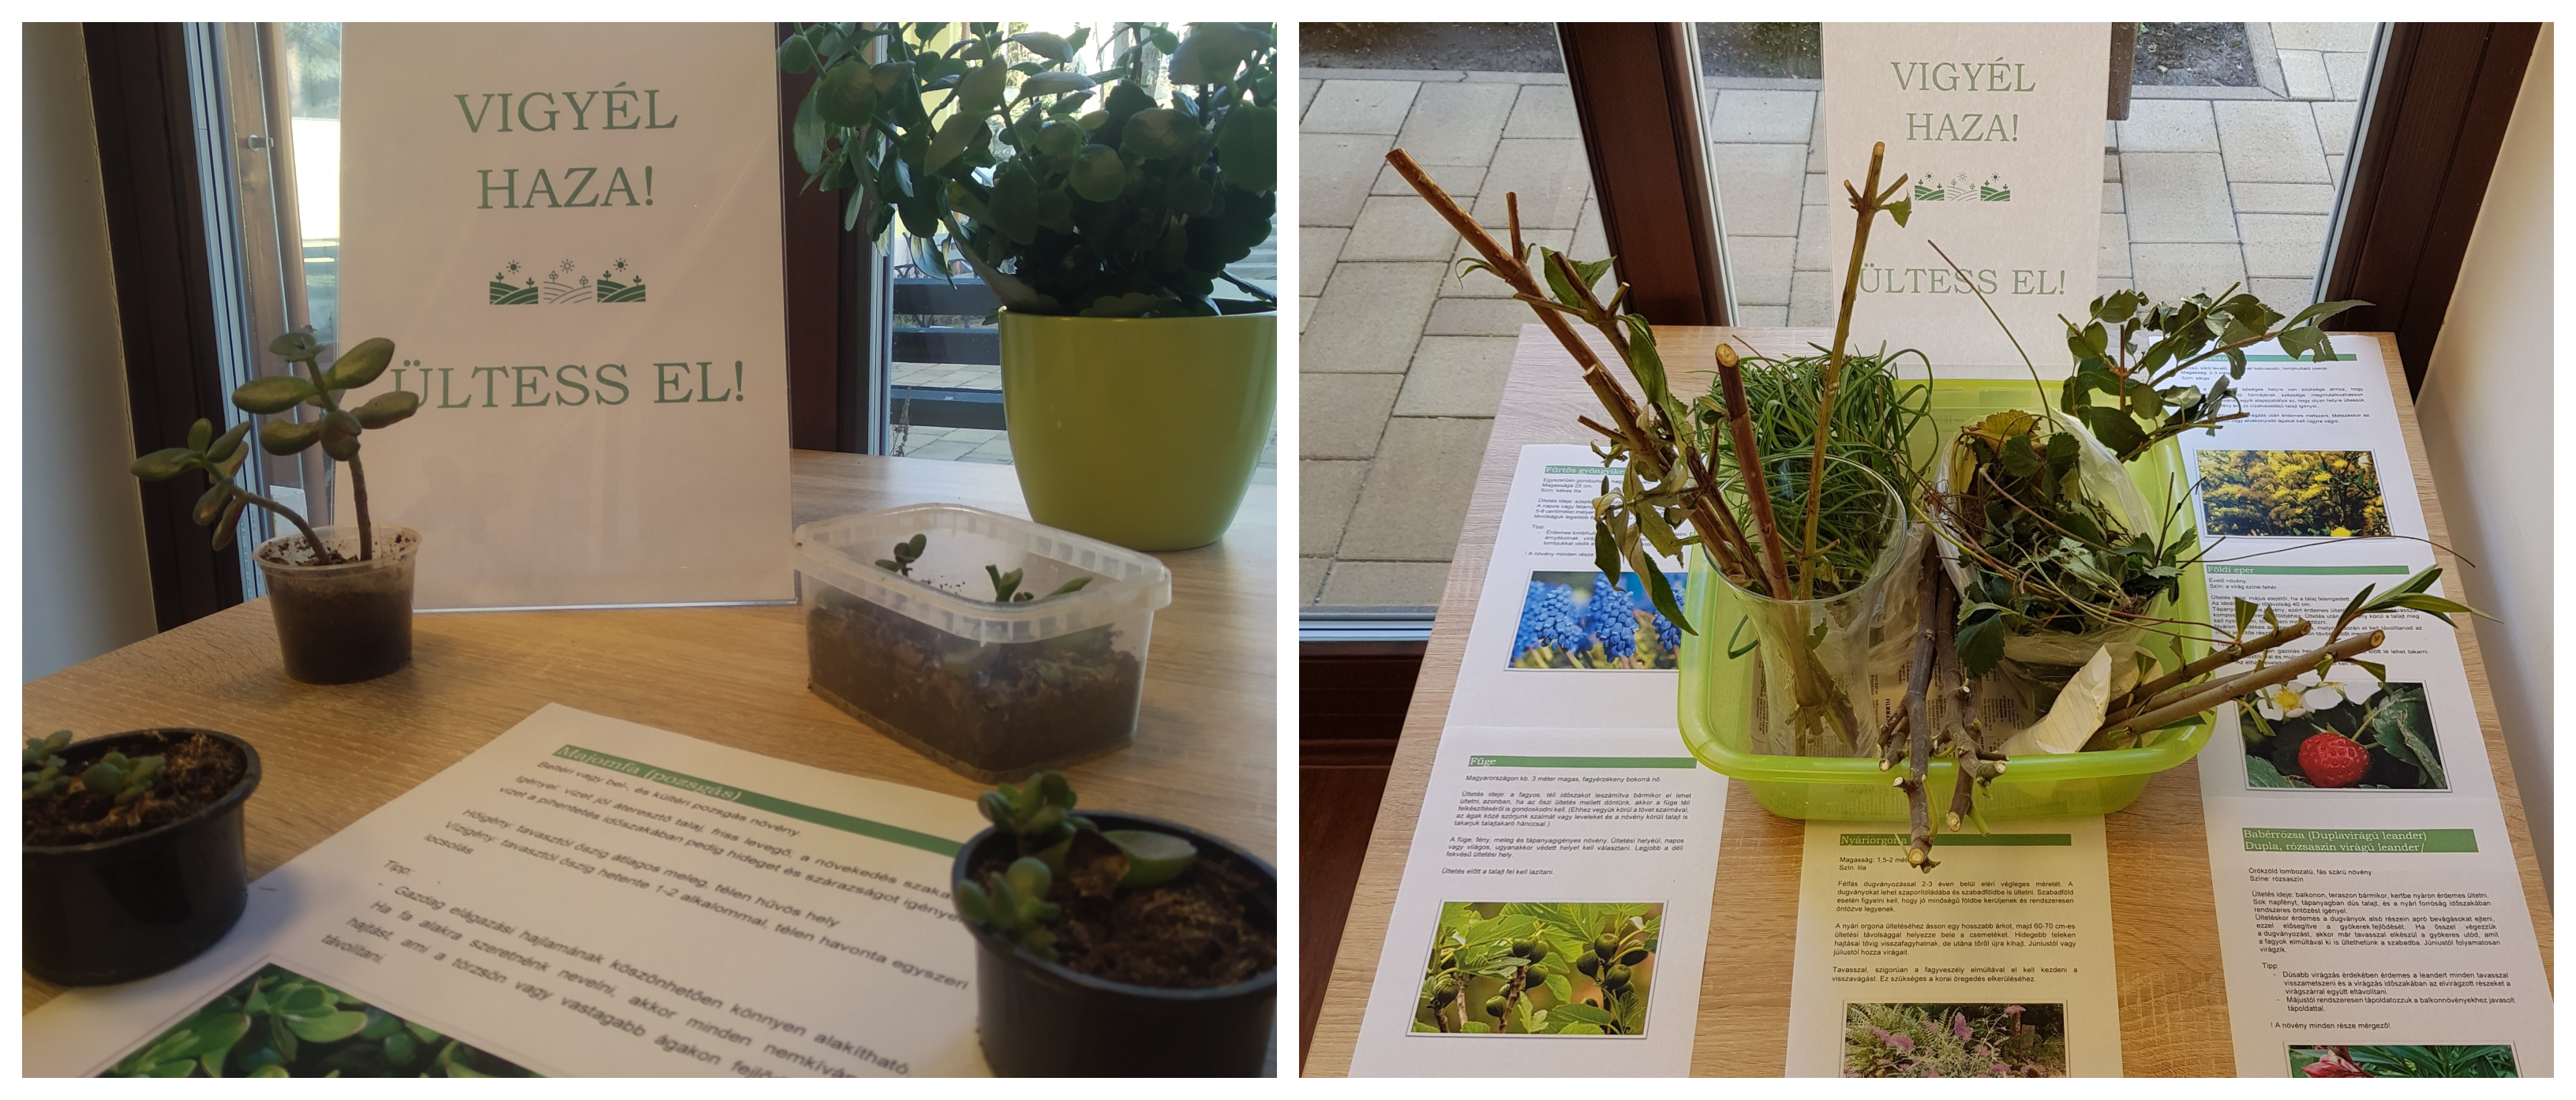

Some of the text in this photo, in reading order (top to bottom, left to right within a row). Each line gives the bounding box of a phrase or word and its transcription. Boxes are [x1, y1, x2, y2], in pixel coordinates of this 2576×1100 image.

[1891, 57, 2036, 92] VIGYÉL
[454, 82, 678, 134] VIGYÉL
[1906, 113, 2019, 142] HAZA!
[477, 166, 655, 210] HAZA!
[1859, 263, 2066, 295] ÜLTESS EL!
[390, 360, 745, 410] ÜLTESS EL!
[556, 746, 743, 803] Majomfa (pozsgás)
[1470, 757, 1496, 766] Füge
[575, 772, 605, 782] vagy
[691, 803, 748, 821] pozsgás
[423, 833, 474, 854] locsolás
[499, 787, 529, 797] vizet
[535, 797, 601, 819] pihentetés
[601, 816, 685, 842] időszakában
[683, 839, 725, 855] pedig
[726, 850, 782, 871] hideget
[783, 867, 803, 877] és
[804, 874, 901, 903] szárazságot
[564, 788, 595, 799] vizet
[612, 803, 673, 821] áteresztő
[710, 828, 740, 840] friss
[814, 859, 898, 883] növekedés
[2243, 829, 2427, 841] Babérrózsa (Duplavirágú leander)
[2245, 842, 2282, 851] Dupla,
[2286, 842, 2336, 851] rózsaszín
[516, 825, 575, 847] tavasztól
[574, 843, 611, 859] őszig
[611, 854, 662, 872] átlagos
[714, 884, 753, 901] télen
[805, 911, 841, 927] hely
[500, 839, 561, 861] tavasztól
[559, 858, 597, 874] őszig
[597, 868, 651, 889] hetente
[655, 885, 680, 896] 1-2
[774, 923, 816, 941] télen
[818, 936, 889, 963] havonta
[892, 960, 972, 990] egyszeri
[369, 900, 393, 914] Ha
[397, 910, 414, 921] fa
[418, 920, 464, 940] alakra
[469, 939, 551, 971] szeretnénk
[628, 996, 679, 1018] akkor
[685, 1018, 754, 1046] minden
[394, 886, 447, 910] Gazdag
[449, 907, 516, 934] elágazási
[519, 930, 605, 963] hajlamának
[608, 959, 724, 1008] köszönhetően
[729, 1003, 808, 1036] könnyen
[400, 939, 430, 953] ami
[451, 957, 508, 983] törzsön
[515, 981, 554, 1000] vagy
[560, 997, 647, 1036] vastagabb
[653, 1035, 723, 1064] ágakon
